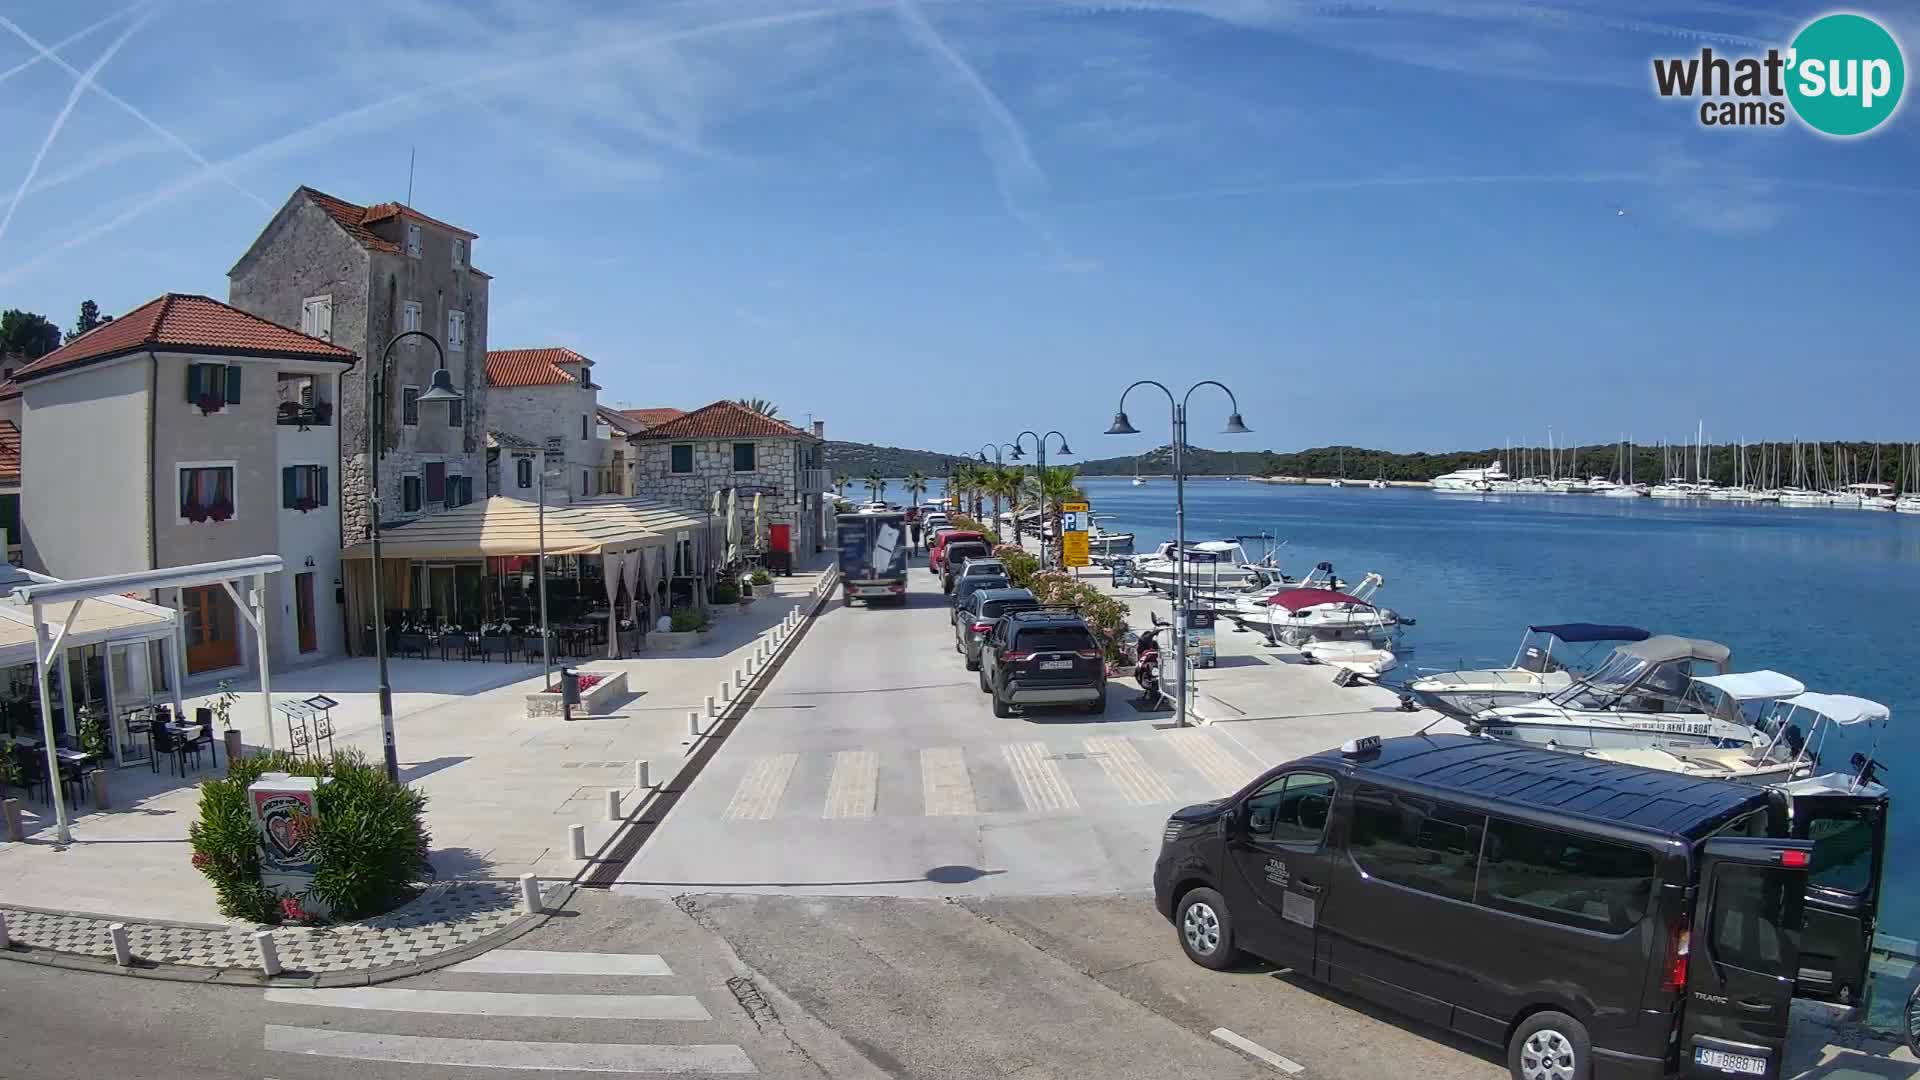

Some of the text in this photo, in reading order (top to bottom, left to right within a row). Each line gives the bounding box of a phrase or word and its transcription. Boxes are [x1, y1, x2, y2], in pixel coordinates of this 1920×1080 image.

[1065, 513, 1076, 530] P
[1693, 724, 1712, 734] BOAT
[1358, 736, 1380, 750] TAXI
[1270, 859, 1285, 871] TAXI
